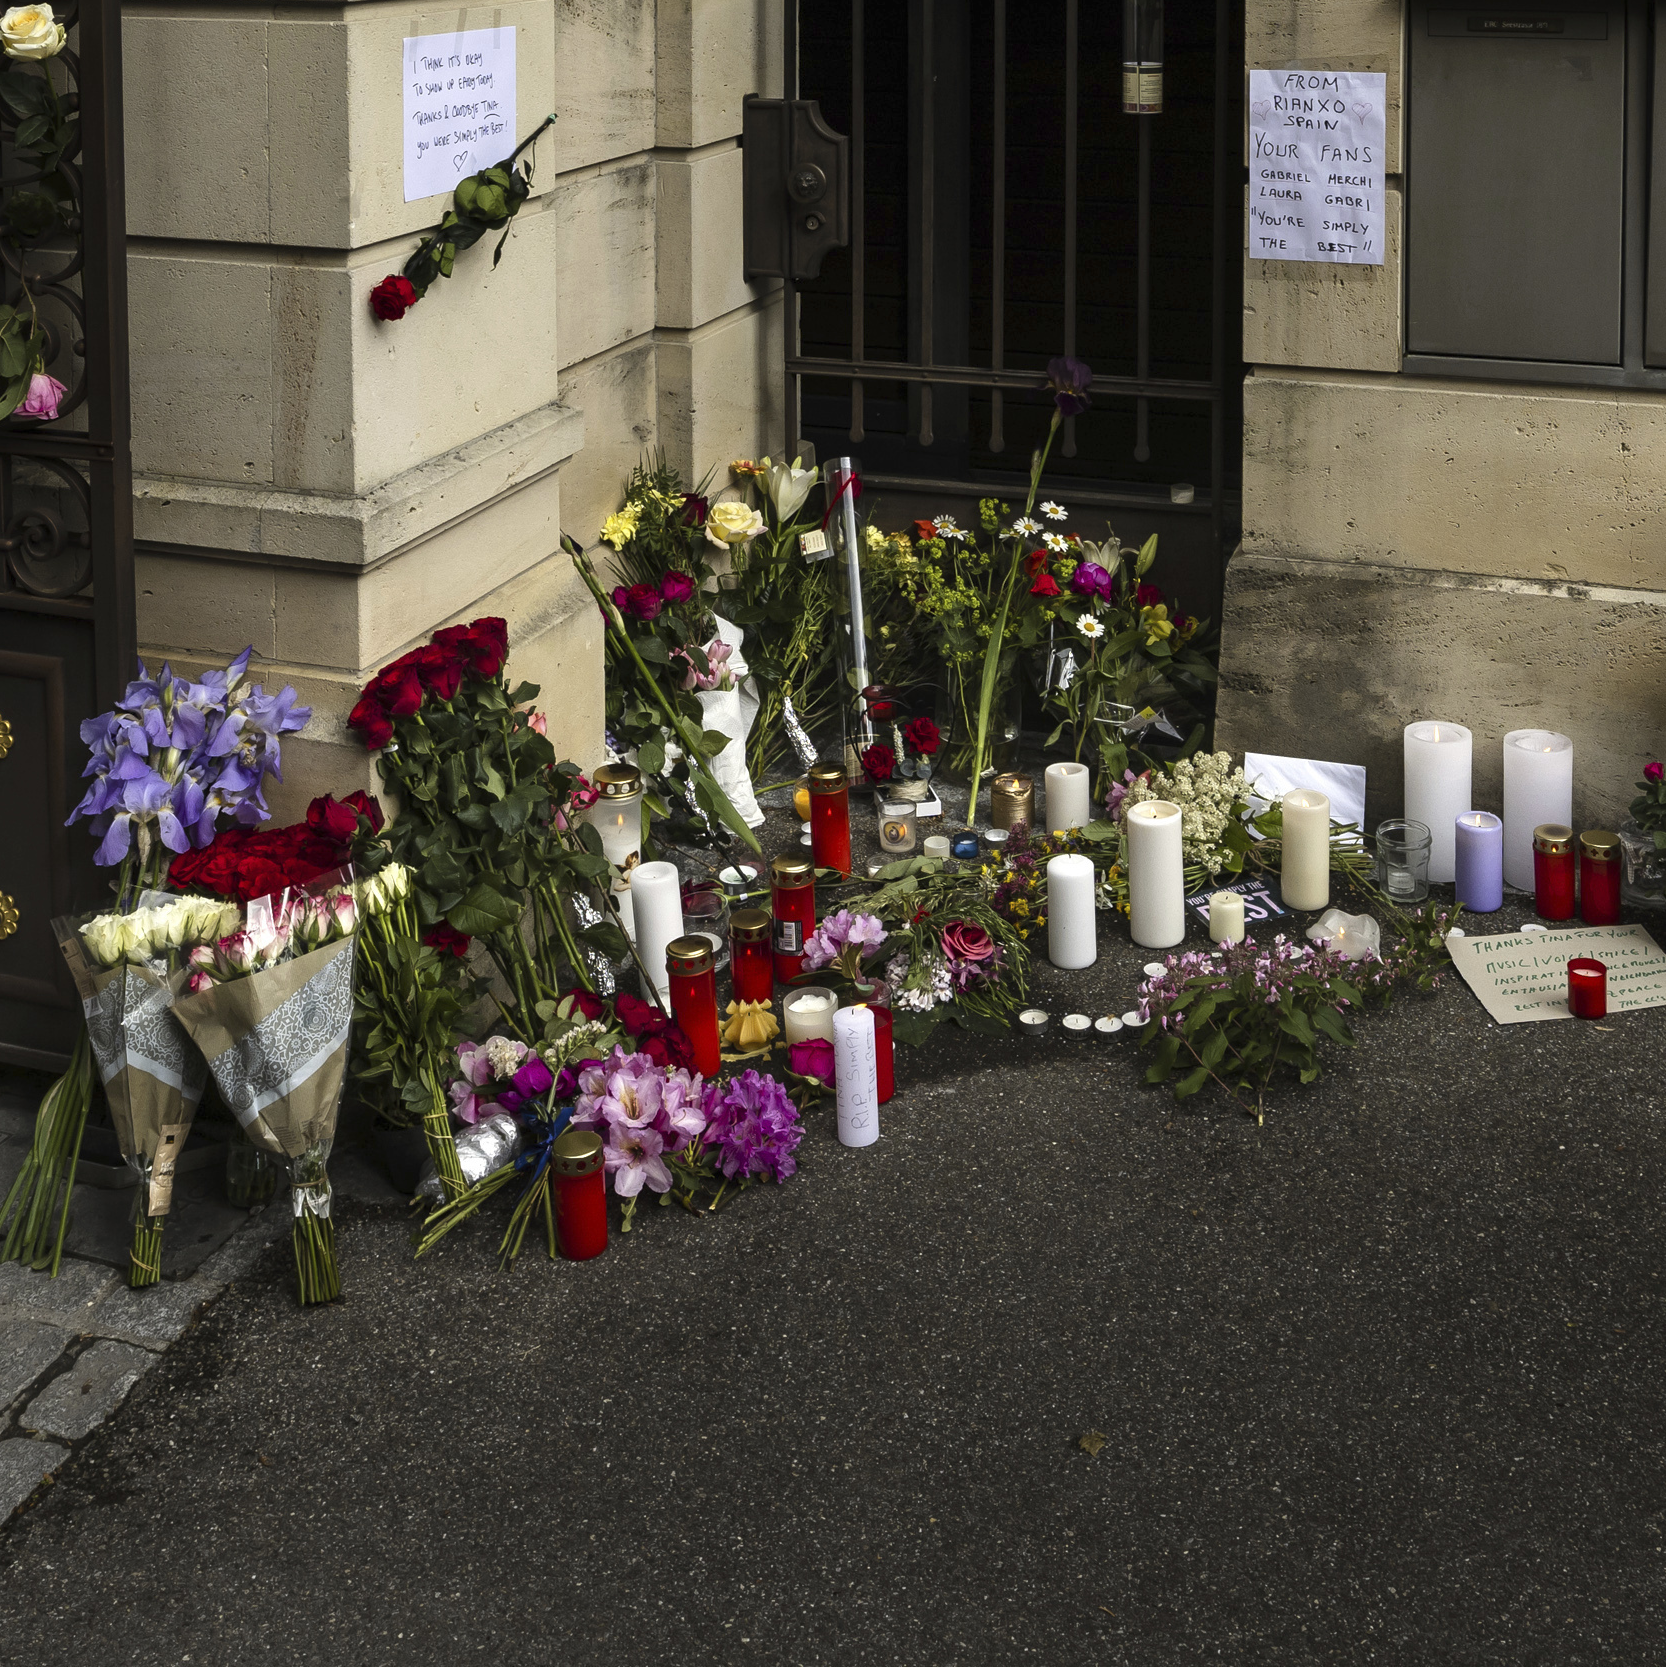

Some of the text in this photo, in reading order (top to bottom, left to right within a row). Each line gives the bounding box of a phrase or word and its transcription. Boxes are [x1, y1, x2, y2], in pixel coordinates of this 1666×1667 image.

[420, 56, 444, 71] THINK
[465, 52, 483, 67] OKAY
[412, 83, 423, 97] TO
[425, 81, 443, 95] SHOW
[446, 78, 455, 90] UP
[1284, 74, 1339, 92] FROM
[412, 111, 443, 126] THANKS
[452, 102, 480, 120] GOODBYE
[1274, 95, 1346, 114] RIANXO
[1283, 115, 1339, 130] SPAIN
[433, 133, 452, 147] WERE
[454, 128, 478, 144] SIMPLY
[478, 124, 489, 138] THE
[1255, 132, 1373, 163] YOUR FANS
[1260, 169, 1372, 189] GABRIEL MERCHI
[1260, 186, 1370, 212] LAURA GABRI
[1322, 220, 1369, 236] SIMPLY
[1259, 237, 1287, 250] THE
[1245, 880, 1265, 890] THE
[1196, 890, 1285, 922] ST
[1472, 937, 1534, 954] THANKS
[1539, 934, 1573, 944] TINA
[1607, 929, 1640, 939] YOUR
[1514, 1001, 1542, 1011] REST
[1619, 984, 1662, 996] PEACE
[1619, 1000, 1642, 1009] THE
